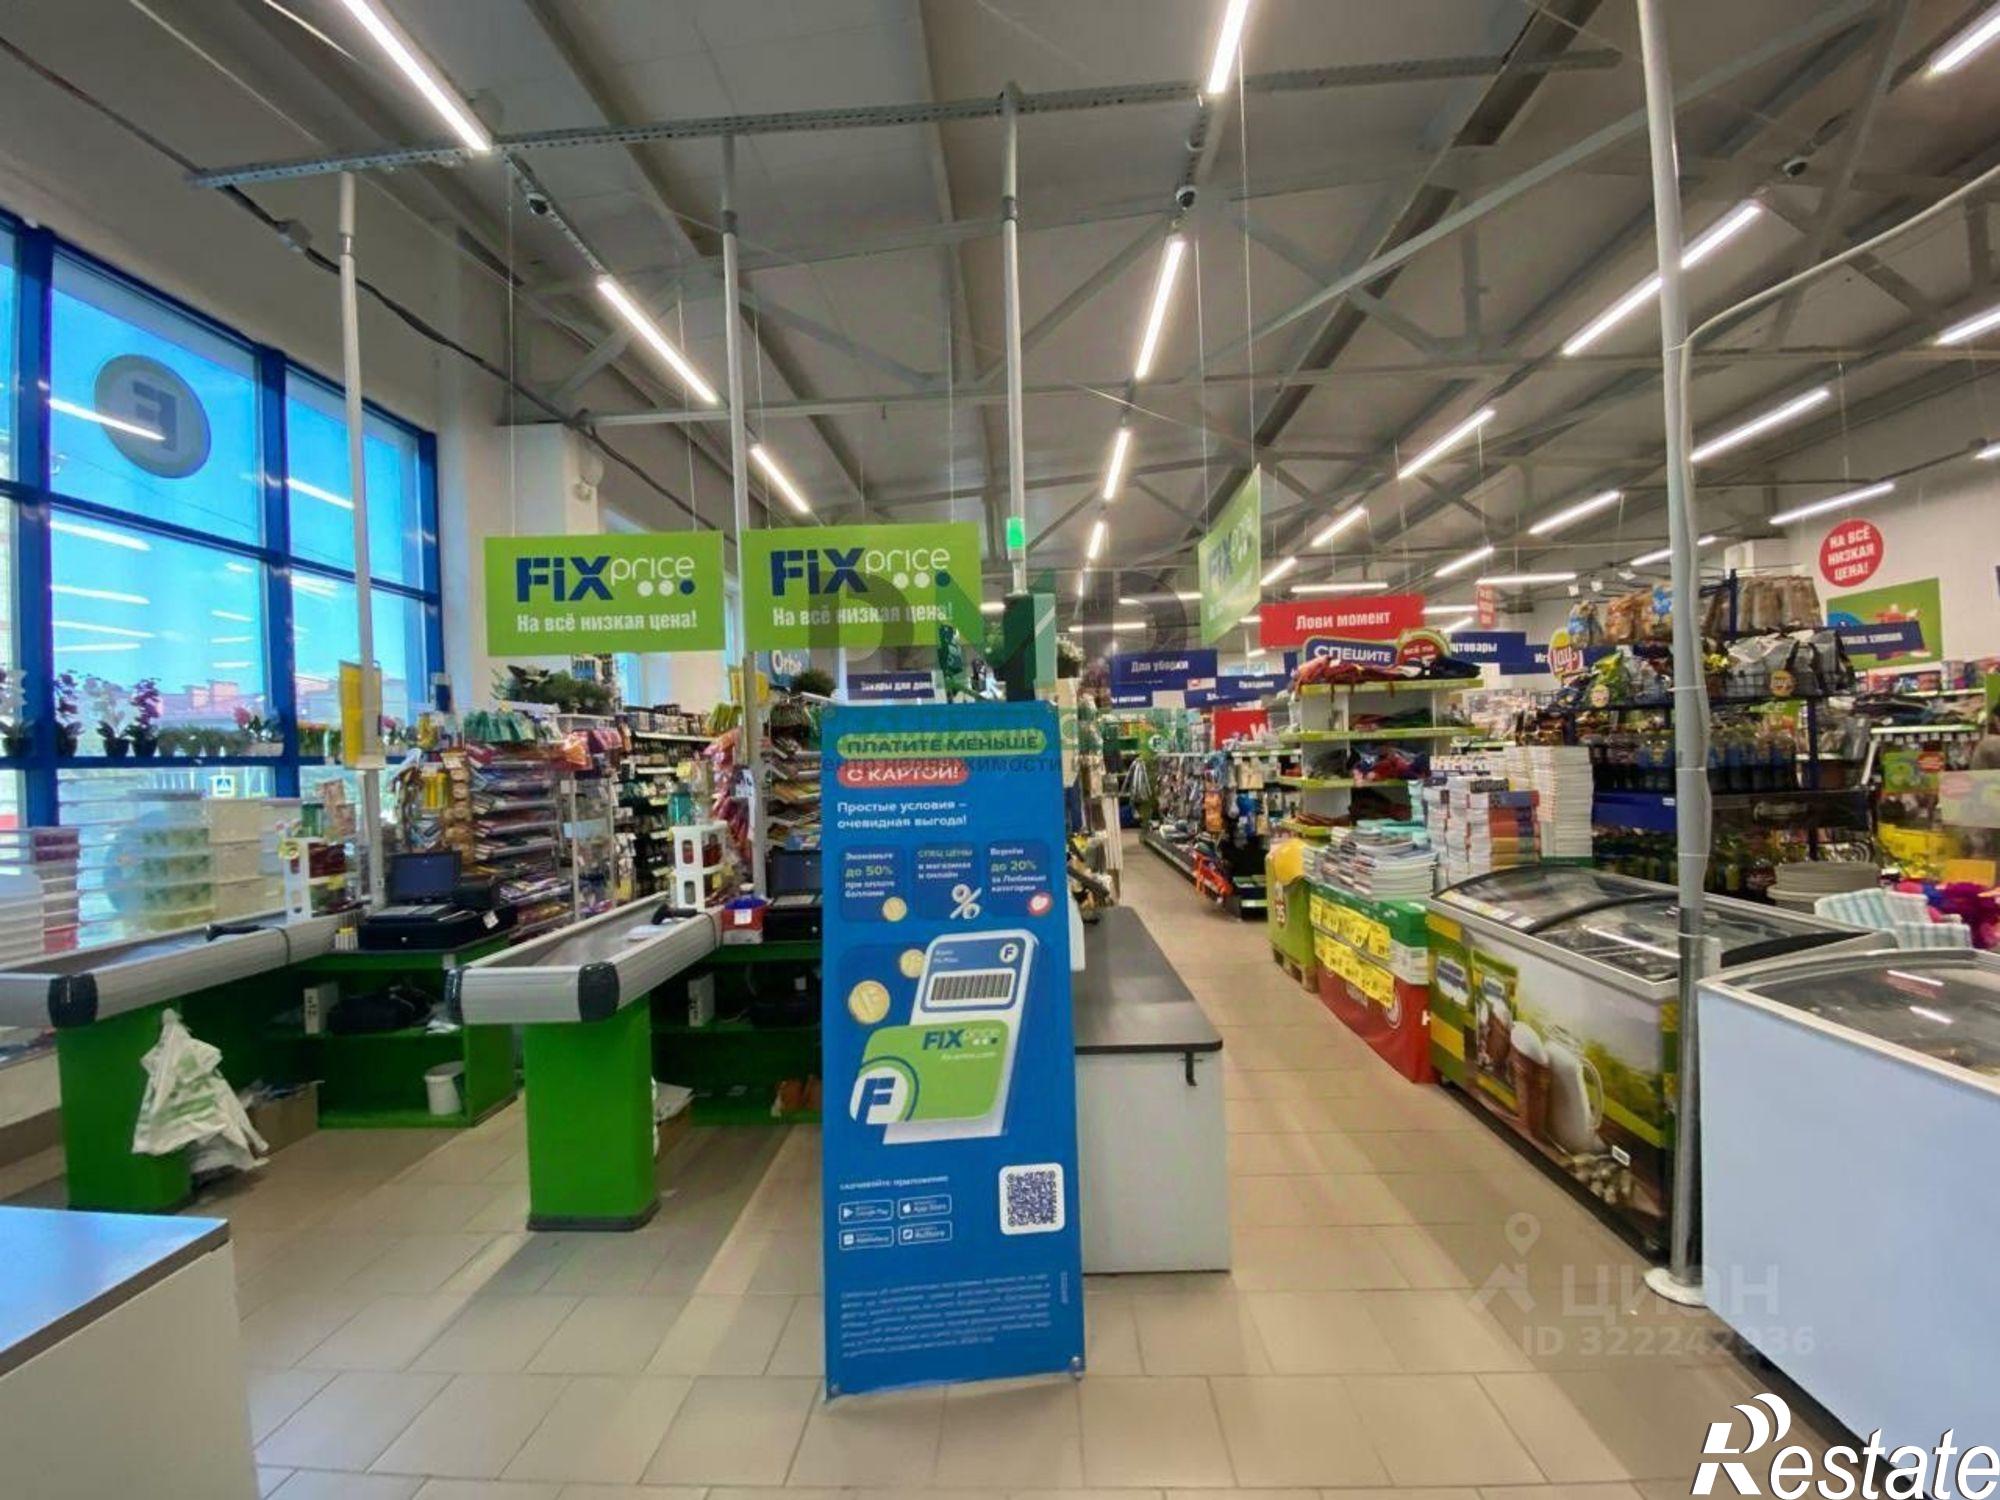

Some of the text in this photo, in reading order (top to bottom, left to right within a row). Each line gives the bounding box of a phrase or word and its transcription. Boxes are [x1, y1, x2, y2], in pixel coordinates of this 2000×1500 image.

[517, 610, 697, 632] На всё низкая цена!
[773, 602, 954, 626] На всё низкая цена!
[1296, 612, 1391, 630] Лови момент
[1313, 644, 1392, 664] СПЕШИТЕ
[1131, 660, 1151, 672] Для
[847, 735, 1038, 755] ПЛАТИТЕ МЕНЬШЕ
[847, 764, 960, 782] С КАРТОЙ!
[837, 802, 897, 816] Простые
[900, 800, 956, 814] условия
[837, 814, 967, 829] очевидная выгода!
[845, 867, 862, 878] до
[856, 1077, 896, 1124] F
